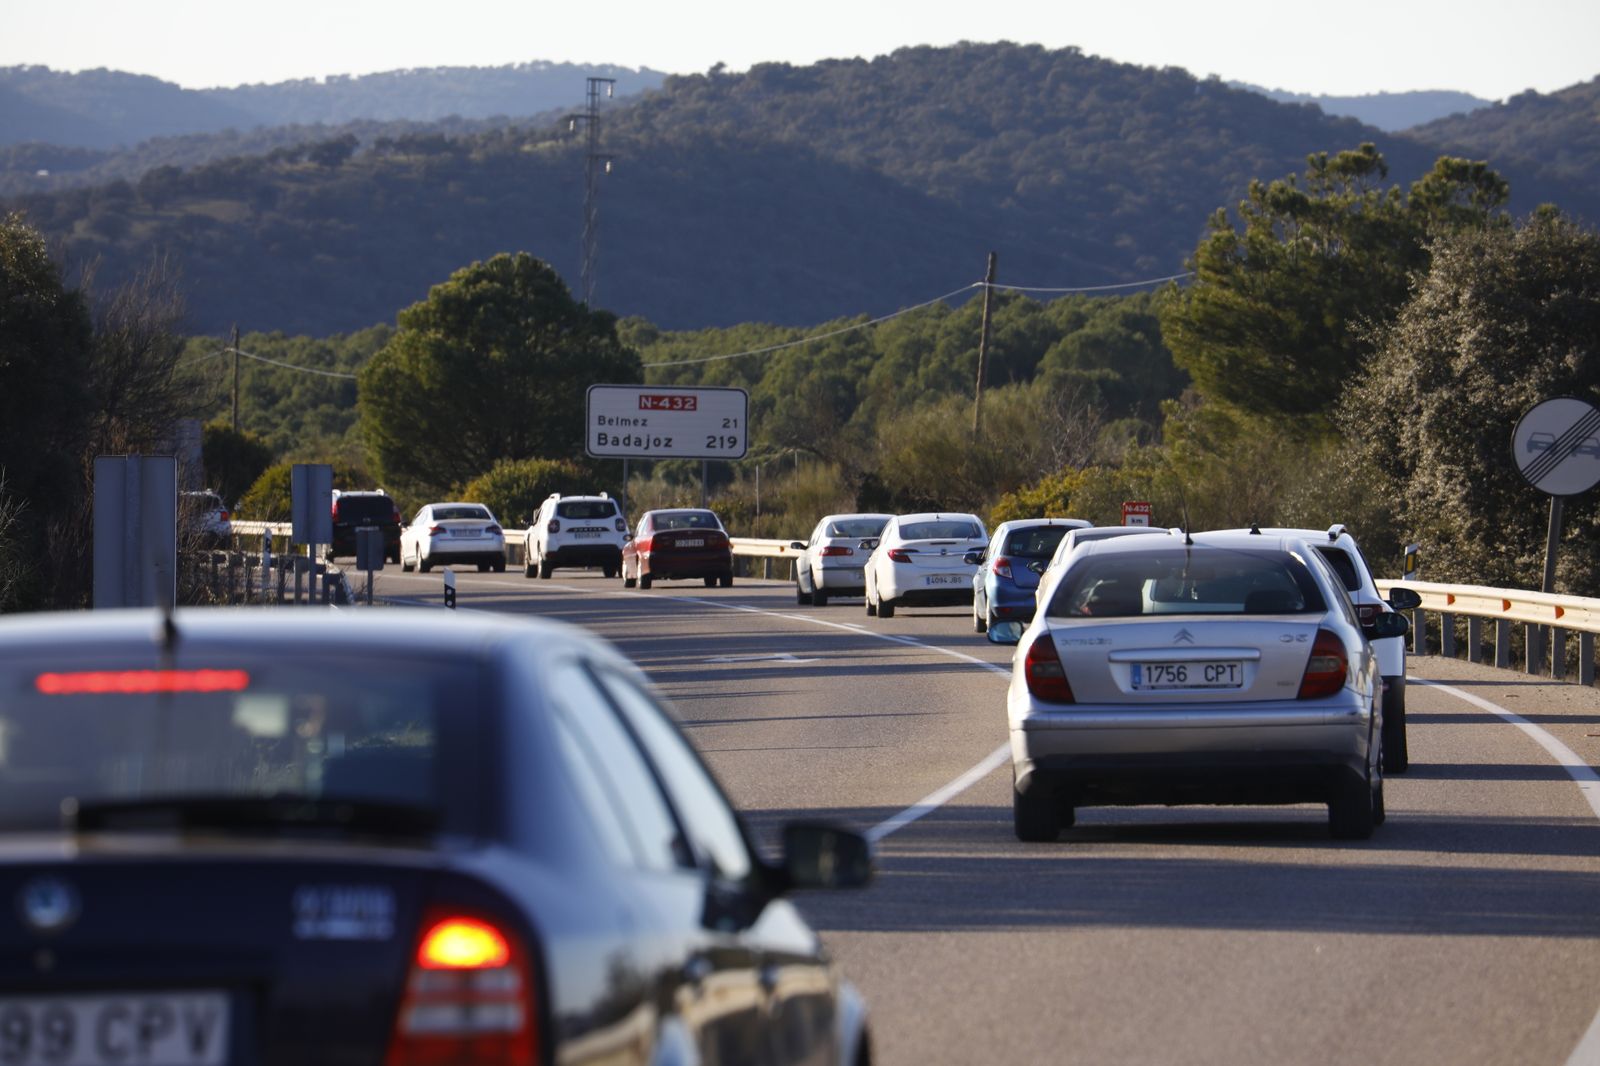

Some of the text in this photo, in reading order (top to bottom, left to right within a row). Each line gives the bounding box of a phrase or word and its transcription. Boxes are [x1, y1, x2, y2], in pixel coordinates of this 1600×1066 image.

[641, 397, 695, 410] N-432
[598, 415, 738, 429] Belmez 21
[597, 433, 737, 450] Badajoz 219
[1146, 664, 1237, 683] 1756 CPT
